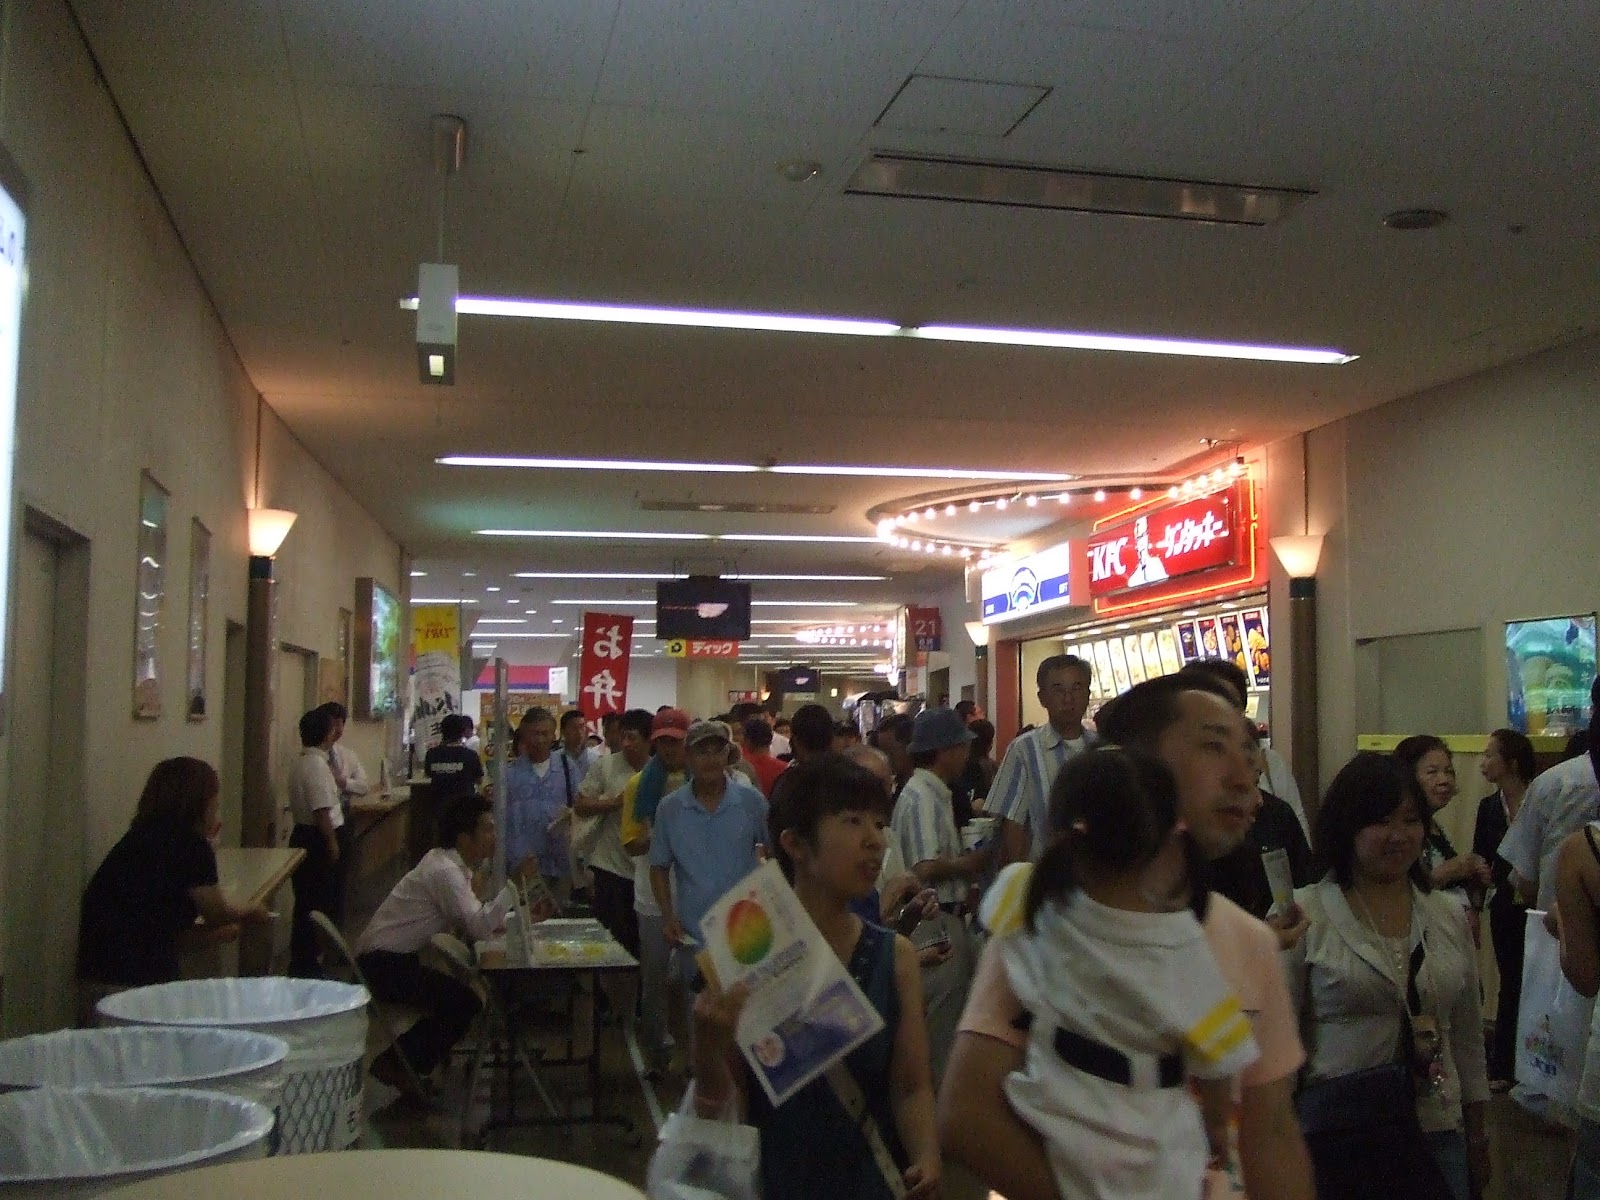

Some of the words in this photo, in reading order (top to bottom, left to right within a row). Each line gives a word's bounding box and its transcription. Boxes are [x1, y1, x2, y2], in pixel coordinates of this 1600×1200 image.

[1087, 536, 1129, 582] KFC
[915, 619, 936, 635] 21
[584, 625, 623, 736] お弁
